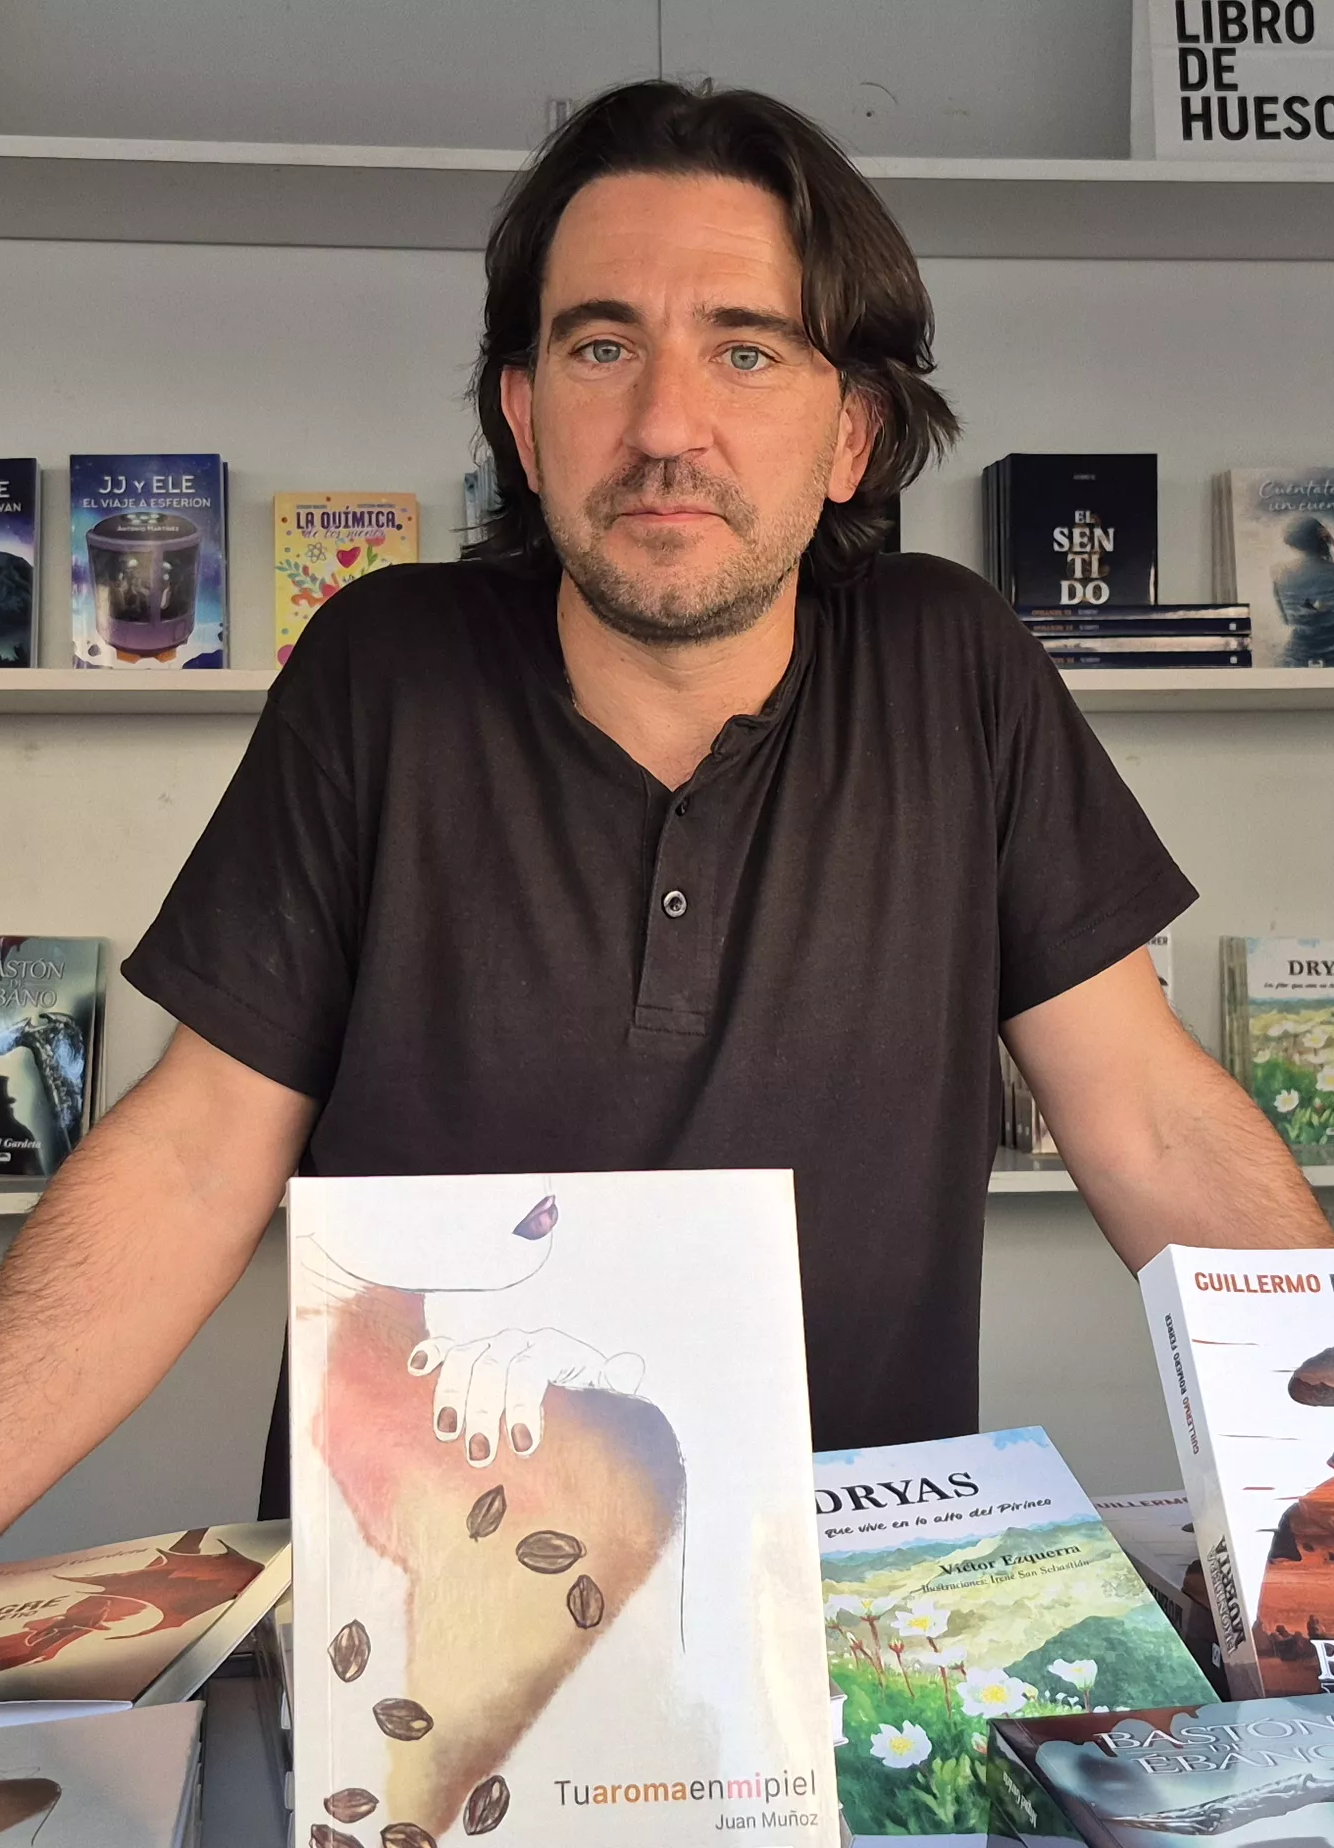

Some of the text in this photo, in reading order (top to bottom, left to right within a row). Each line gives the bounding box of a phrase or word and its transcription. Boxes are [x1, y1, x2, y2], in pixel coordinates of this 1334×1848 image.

[1175, 0, 1315, 44] LIBRO
[1177, 47, 1238, 92] DE
[98, 475, 196, 494] JJ ELE
[83, 497, 211, 508] EL VIAJE ESFERION
[1269, 500, 1294, 513] un
[296, 511, 315, 529] LA
[1074, 510, 1094, 524] EL
[1053, 526, 1115, 552] SEN
[1067, 554, 1101, 579] TI
[1059, 580, 1110, 605] DO
[4, 1138, 41, 1149] Gardeta
[1194, 1271, 1322, 1295] GUILLERMO
[1164, 1313, 1200, 1455] GUILLERMO ROMERO FERRER
[814, 1471, 980, 1515] DRYAS
[825, 1498, 1052, 1539] que vive en lo alto del Pirineo
[940, 1543, 1081, 1576] Víctor Ezquerra
[920, 1559, 1090, 1594] Ilustraciones: Irene San Sebastián
[553, 1769, 816, 1806] Tuaromaenmipiel
[715, 1809, 819, 1830] Juan Muñoz
